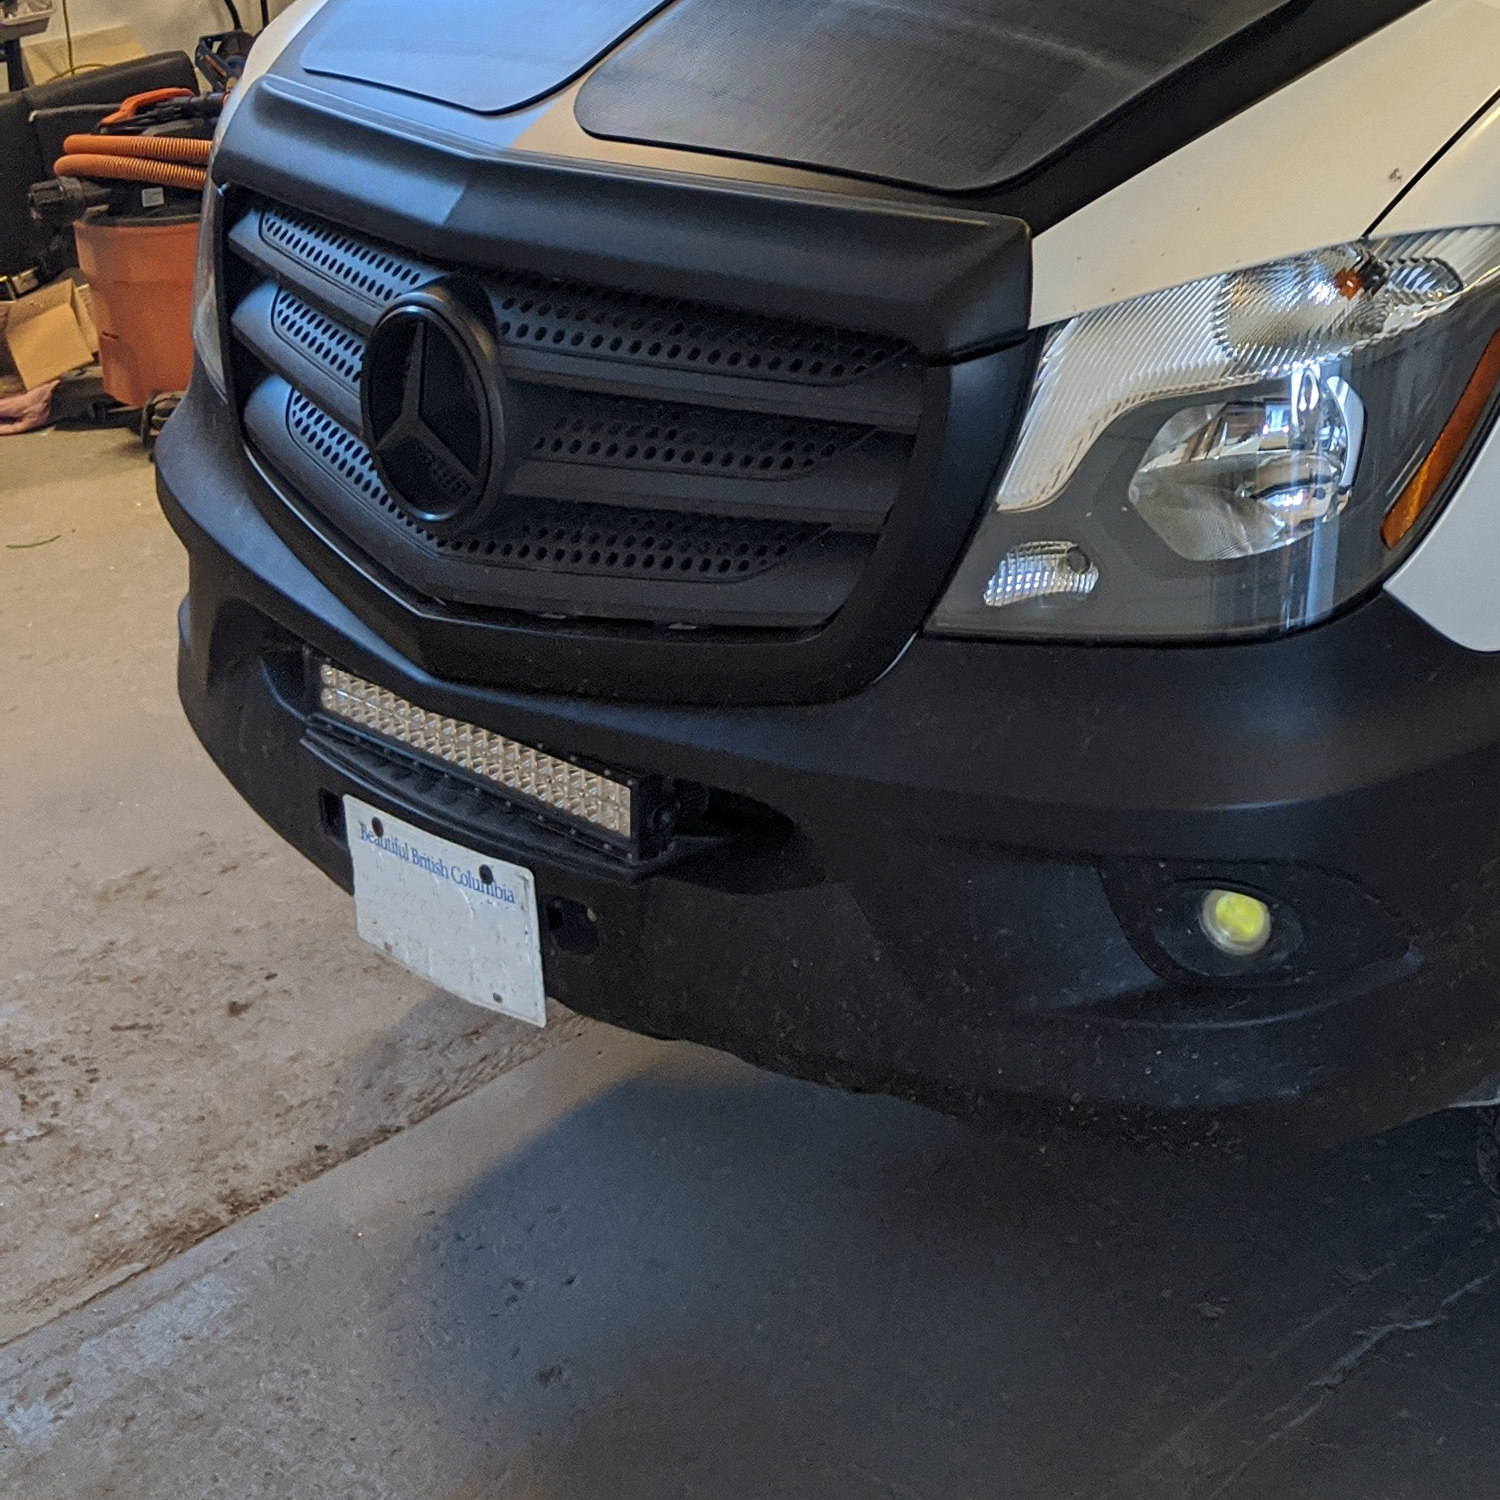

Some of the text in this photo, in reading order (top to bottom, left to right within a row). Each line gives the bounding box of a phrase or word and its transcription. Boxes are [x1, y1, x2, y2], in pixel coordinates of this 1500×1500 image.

[359, 821, 516, 905] Beautiful British Columbia
